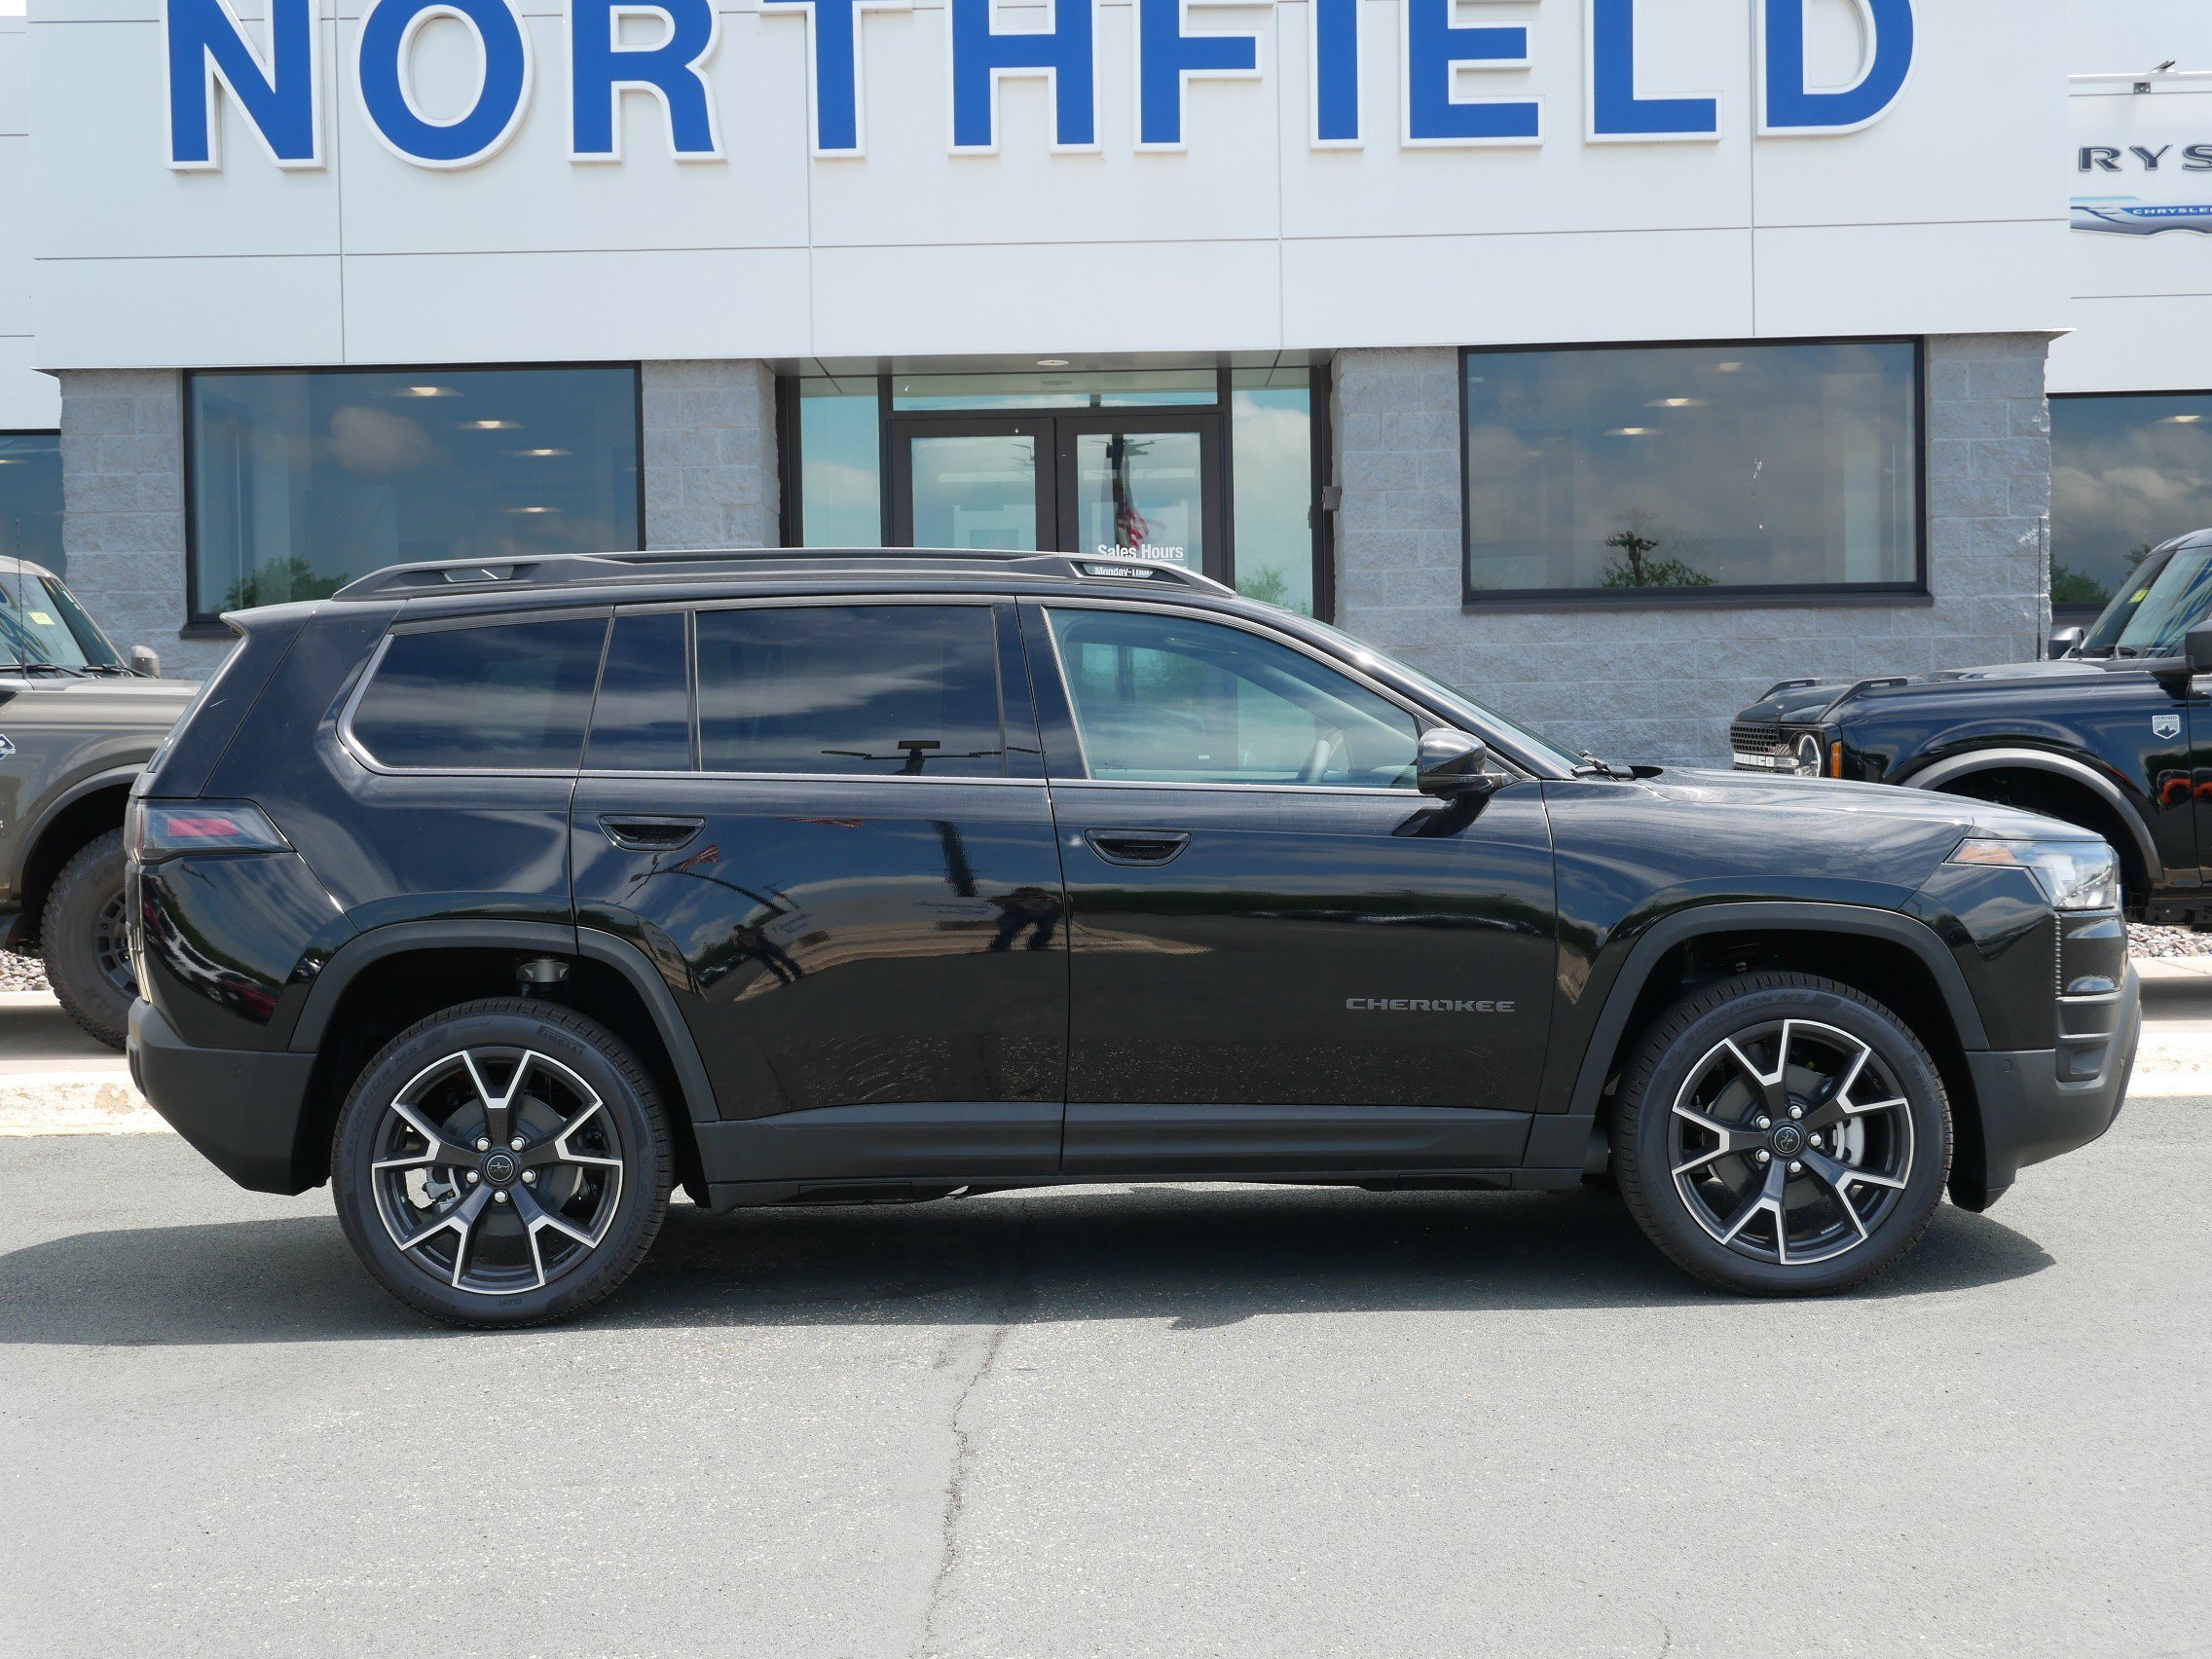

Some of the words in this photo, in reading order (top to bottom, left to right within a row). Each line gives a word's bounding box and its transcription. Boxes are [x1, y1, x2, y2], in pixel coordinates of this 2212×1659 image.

[167, 0, 1918, 167] NORTHFIELD
[1097, 543, 1137, 558] Sales
[1141, 543, 1184, 559] Hours
[1346, 998, 1515, 1013] CHEROKEE
